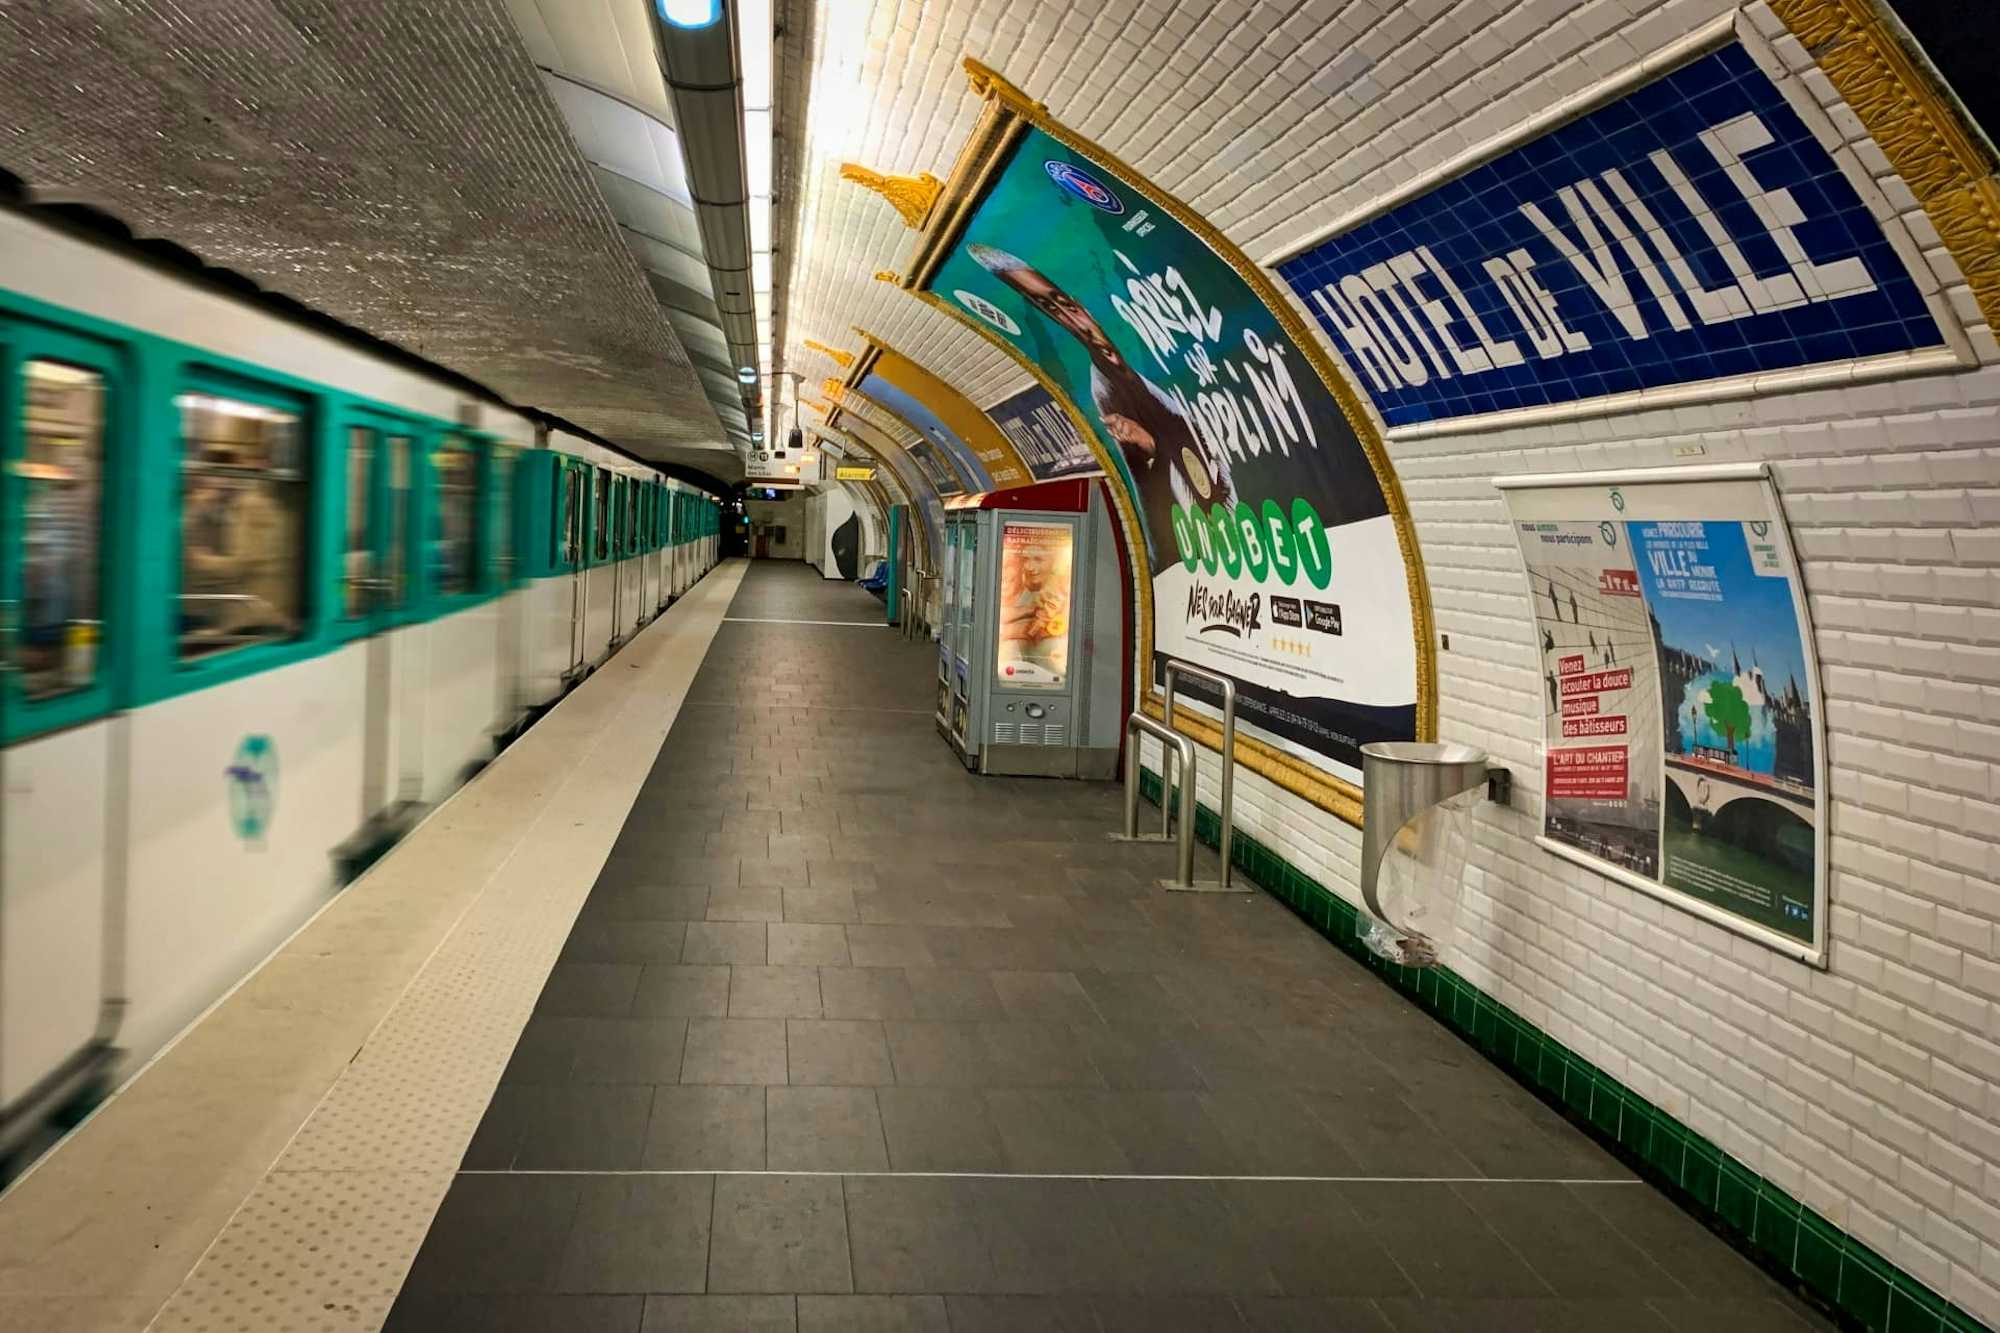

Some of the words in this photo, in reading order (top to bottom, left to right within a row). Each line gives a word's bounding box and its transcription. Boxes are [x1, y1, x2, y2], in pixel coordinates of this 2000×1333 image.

[1518, 111, 1878, 340] VILLE
[1311, 245, 1525, 392] HOTEL
[1481, 247, 1592, 360] DE
[1183, 342, 1218, 387] SUR
[1175, 514, 1323, 572] UNIBET
[1647, 550, 1690, 577] VILLE
[1186, 578, 1208, 625] NÉS
[1208, 594, 1225, 619] POUR
[1225, 589, 1262, 639] GAGNER
[1559, 660, 1583, 674] Venez
[1562, 677, 1591, 694] écouter
[1592, 675, 1601, 689] la
[1602, 673, 1629, 688] douce
[1562, 698, 1597, 717] musique
[1563, 721, 1578, 736] des
[1579, 718, 1625, 735] bâtisseurs
[1575, 752, 1586, 765] DU
